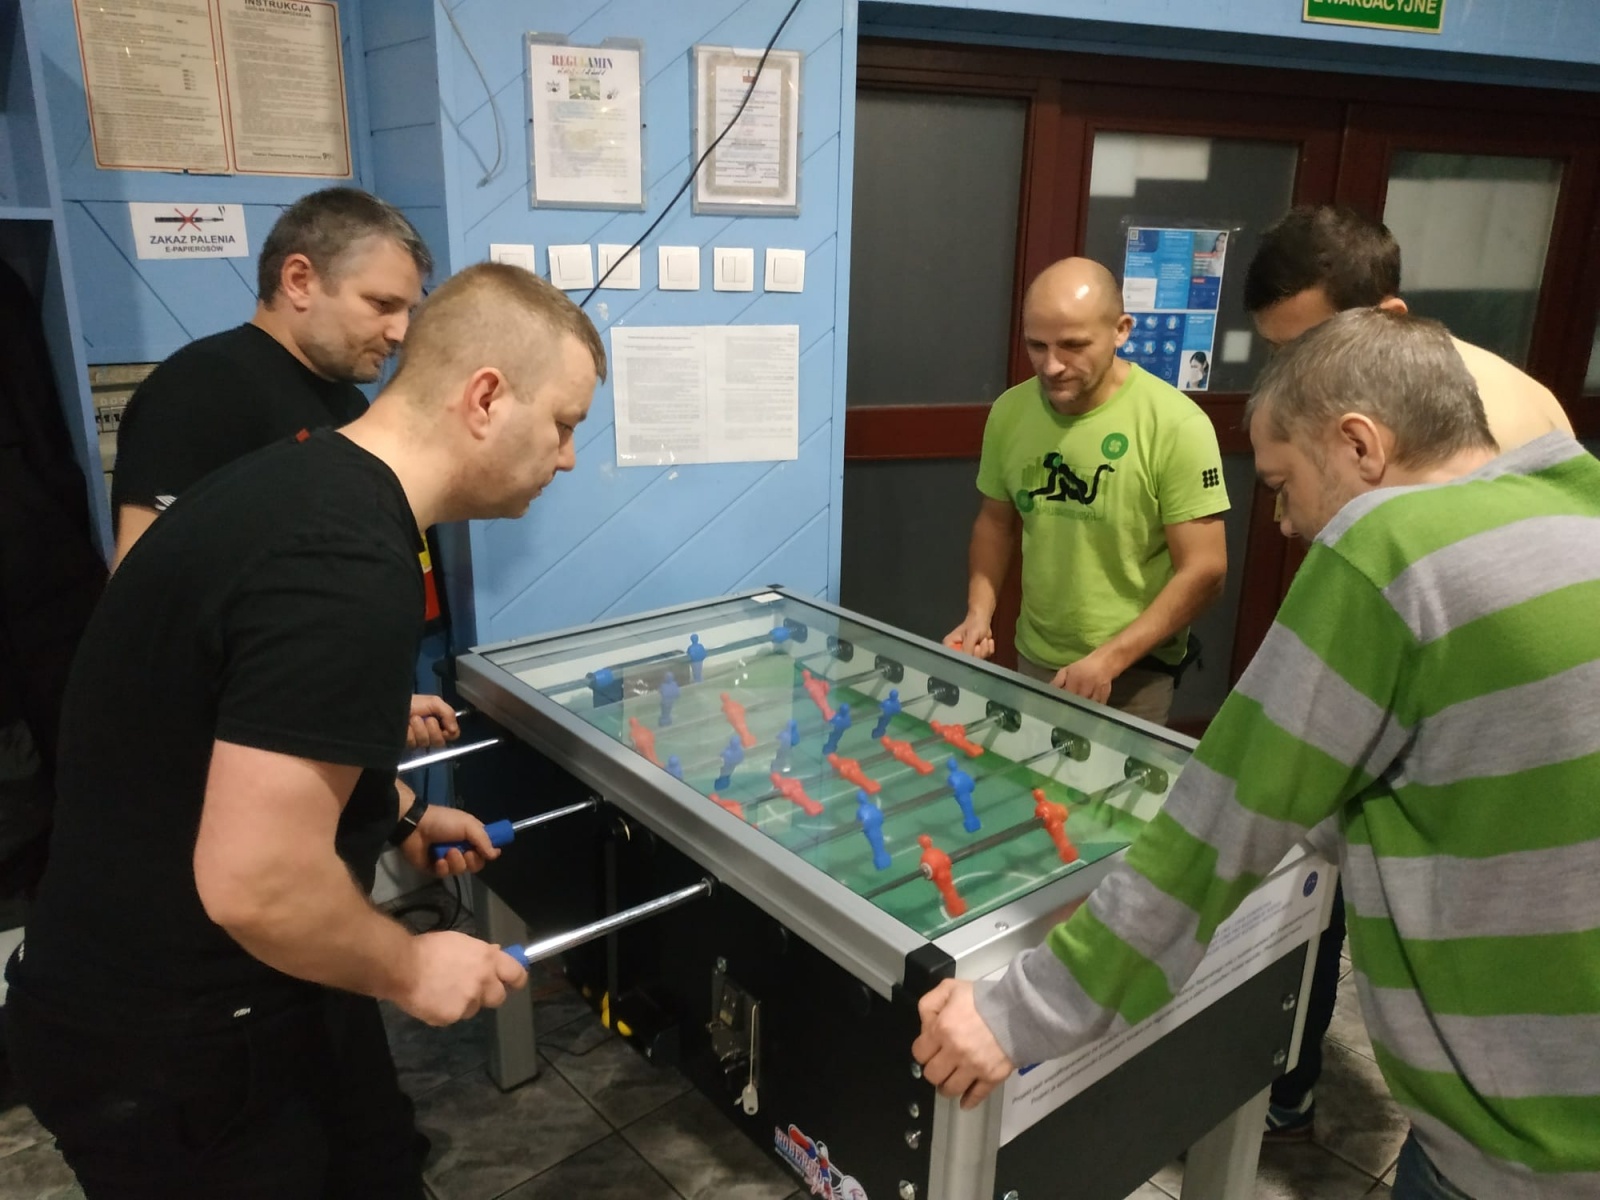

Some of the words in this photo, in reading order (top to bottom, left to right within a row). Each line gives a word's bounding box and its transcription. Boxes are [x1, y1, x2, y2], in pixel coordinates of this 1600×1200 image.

[1313, 0, 1437, 14] UACYJNE
[149, 235, 188, 245] ZAKAZ
[190, 235, 236, 244] PALENIA
[165, 244, 224, 253] E-PAPIEROSÓW
